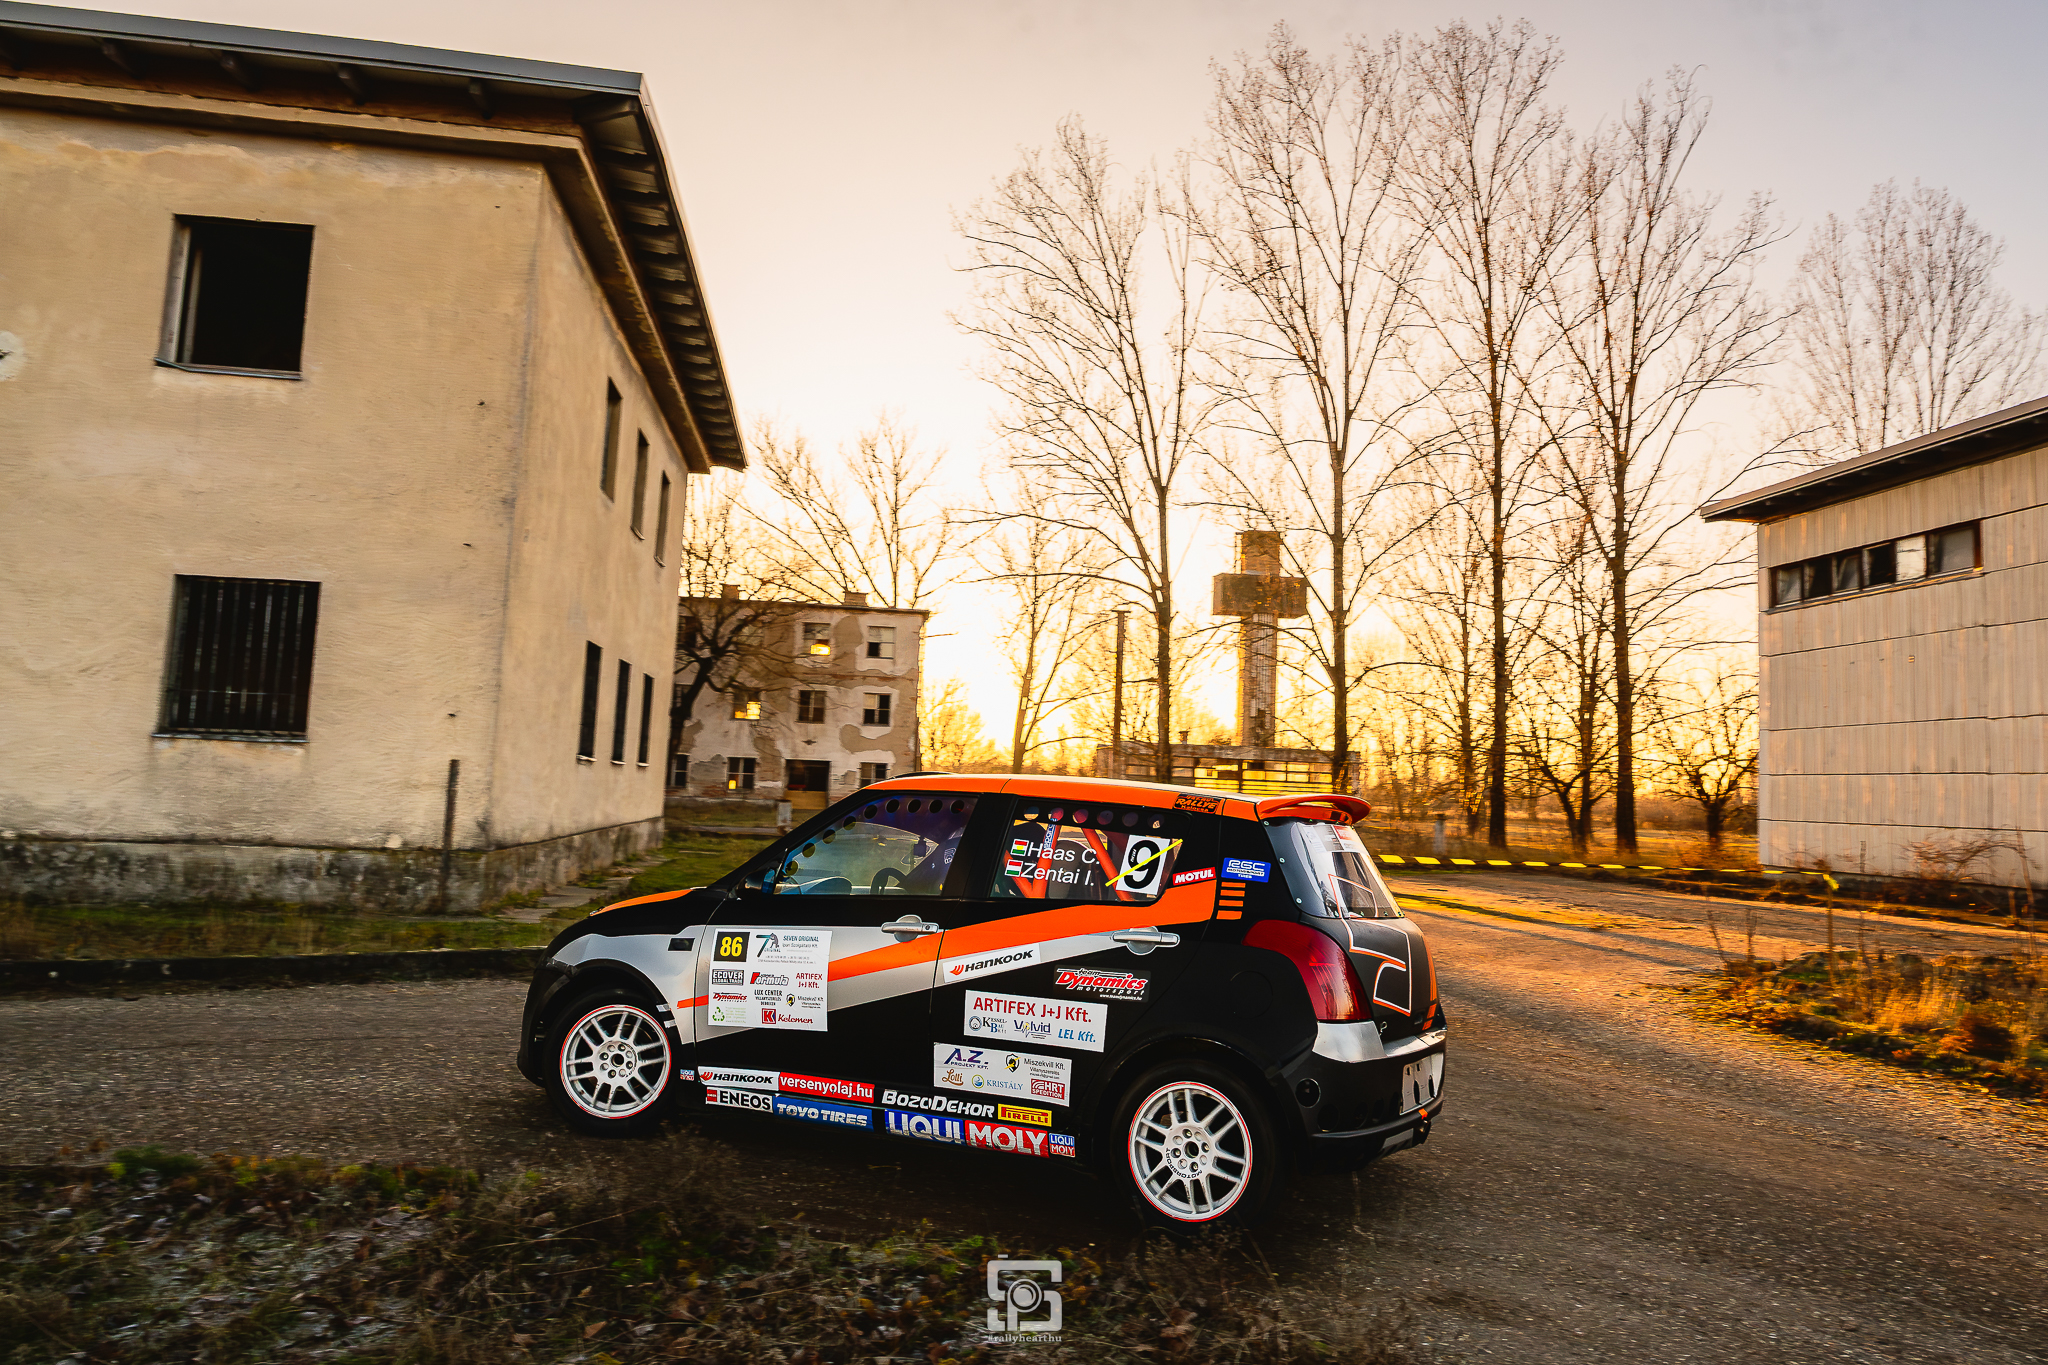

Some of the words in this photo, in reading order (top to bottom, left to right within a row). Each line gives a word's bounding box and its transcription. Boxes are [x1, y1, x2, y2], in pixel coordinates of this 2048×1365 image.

[1176, 798, 1218, 809] RALLYE
[1027, 841, 1075, 862] Haas
[1081, 848, 1100, 865] C.
[1124, 840, 1160, 889] 9
[1021, 862, 1080, 884] Zentai
[1174, 869, 1214, 884] MOTUL
[720, 936, 743, 957] 86
[713, 971, 743, 980] ECOVER
[796, 972, 823, 980] ARTIFEX
[1055, 971, 1148, 990] Dynamics
[808, 981, 820, 989] Kft.
[1077, 987, 1145, 996] motorsport
[713, 993, 747, 1001] Dynamics
[973, 997, 1036, 1016] ARTIFEX
[1041, 1004, 1061, 1019] J+J
[1066, 1006, 1091, 1022] Kft.
[1058, 1028, 1074, 1040] LEL
[1078, 1030, 1096, 1043] Kft.
[944, 1048, 989, 1064] A.Z.
[1055, 1062, 1066, 1070] Kft.
[942, 1068, 964, 1086] Lolli
[986, 1079, 1024, 1090] KRISTÁLY
[780, 1076, 872, 1098] versenyolaj.hu
[1032, 1089, 1062, 1098] SPEDITION
[1044, 1082, 1064, 1093] HRT
[720, 1090, 770, 1110] ENEOS
[777, 1103, 819, 1119] TOYO
[821, 1110, 868, 1126] TIRES
[1001, 1107, 1048, 1124] PIRELLI
[888, 1111, 962, 1144] LIQUI
[968, 1122, 1046, 1156] MOLY
[1050, 1135, 1074, 1146] LIQUI
[1052, 1145, 1074, 1156] MOLY
